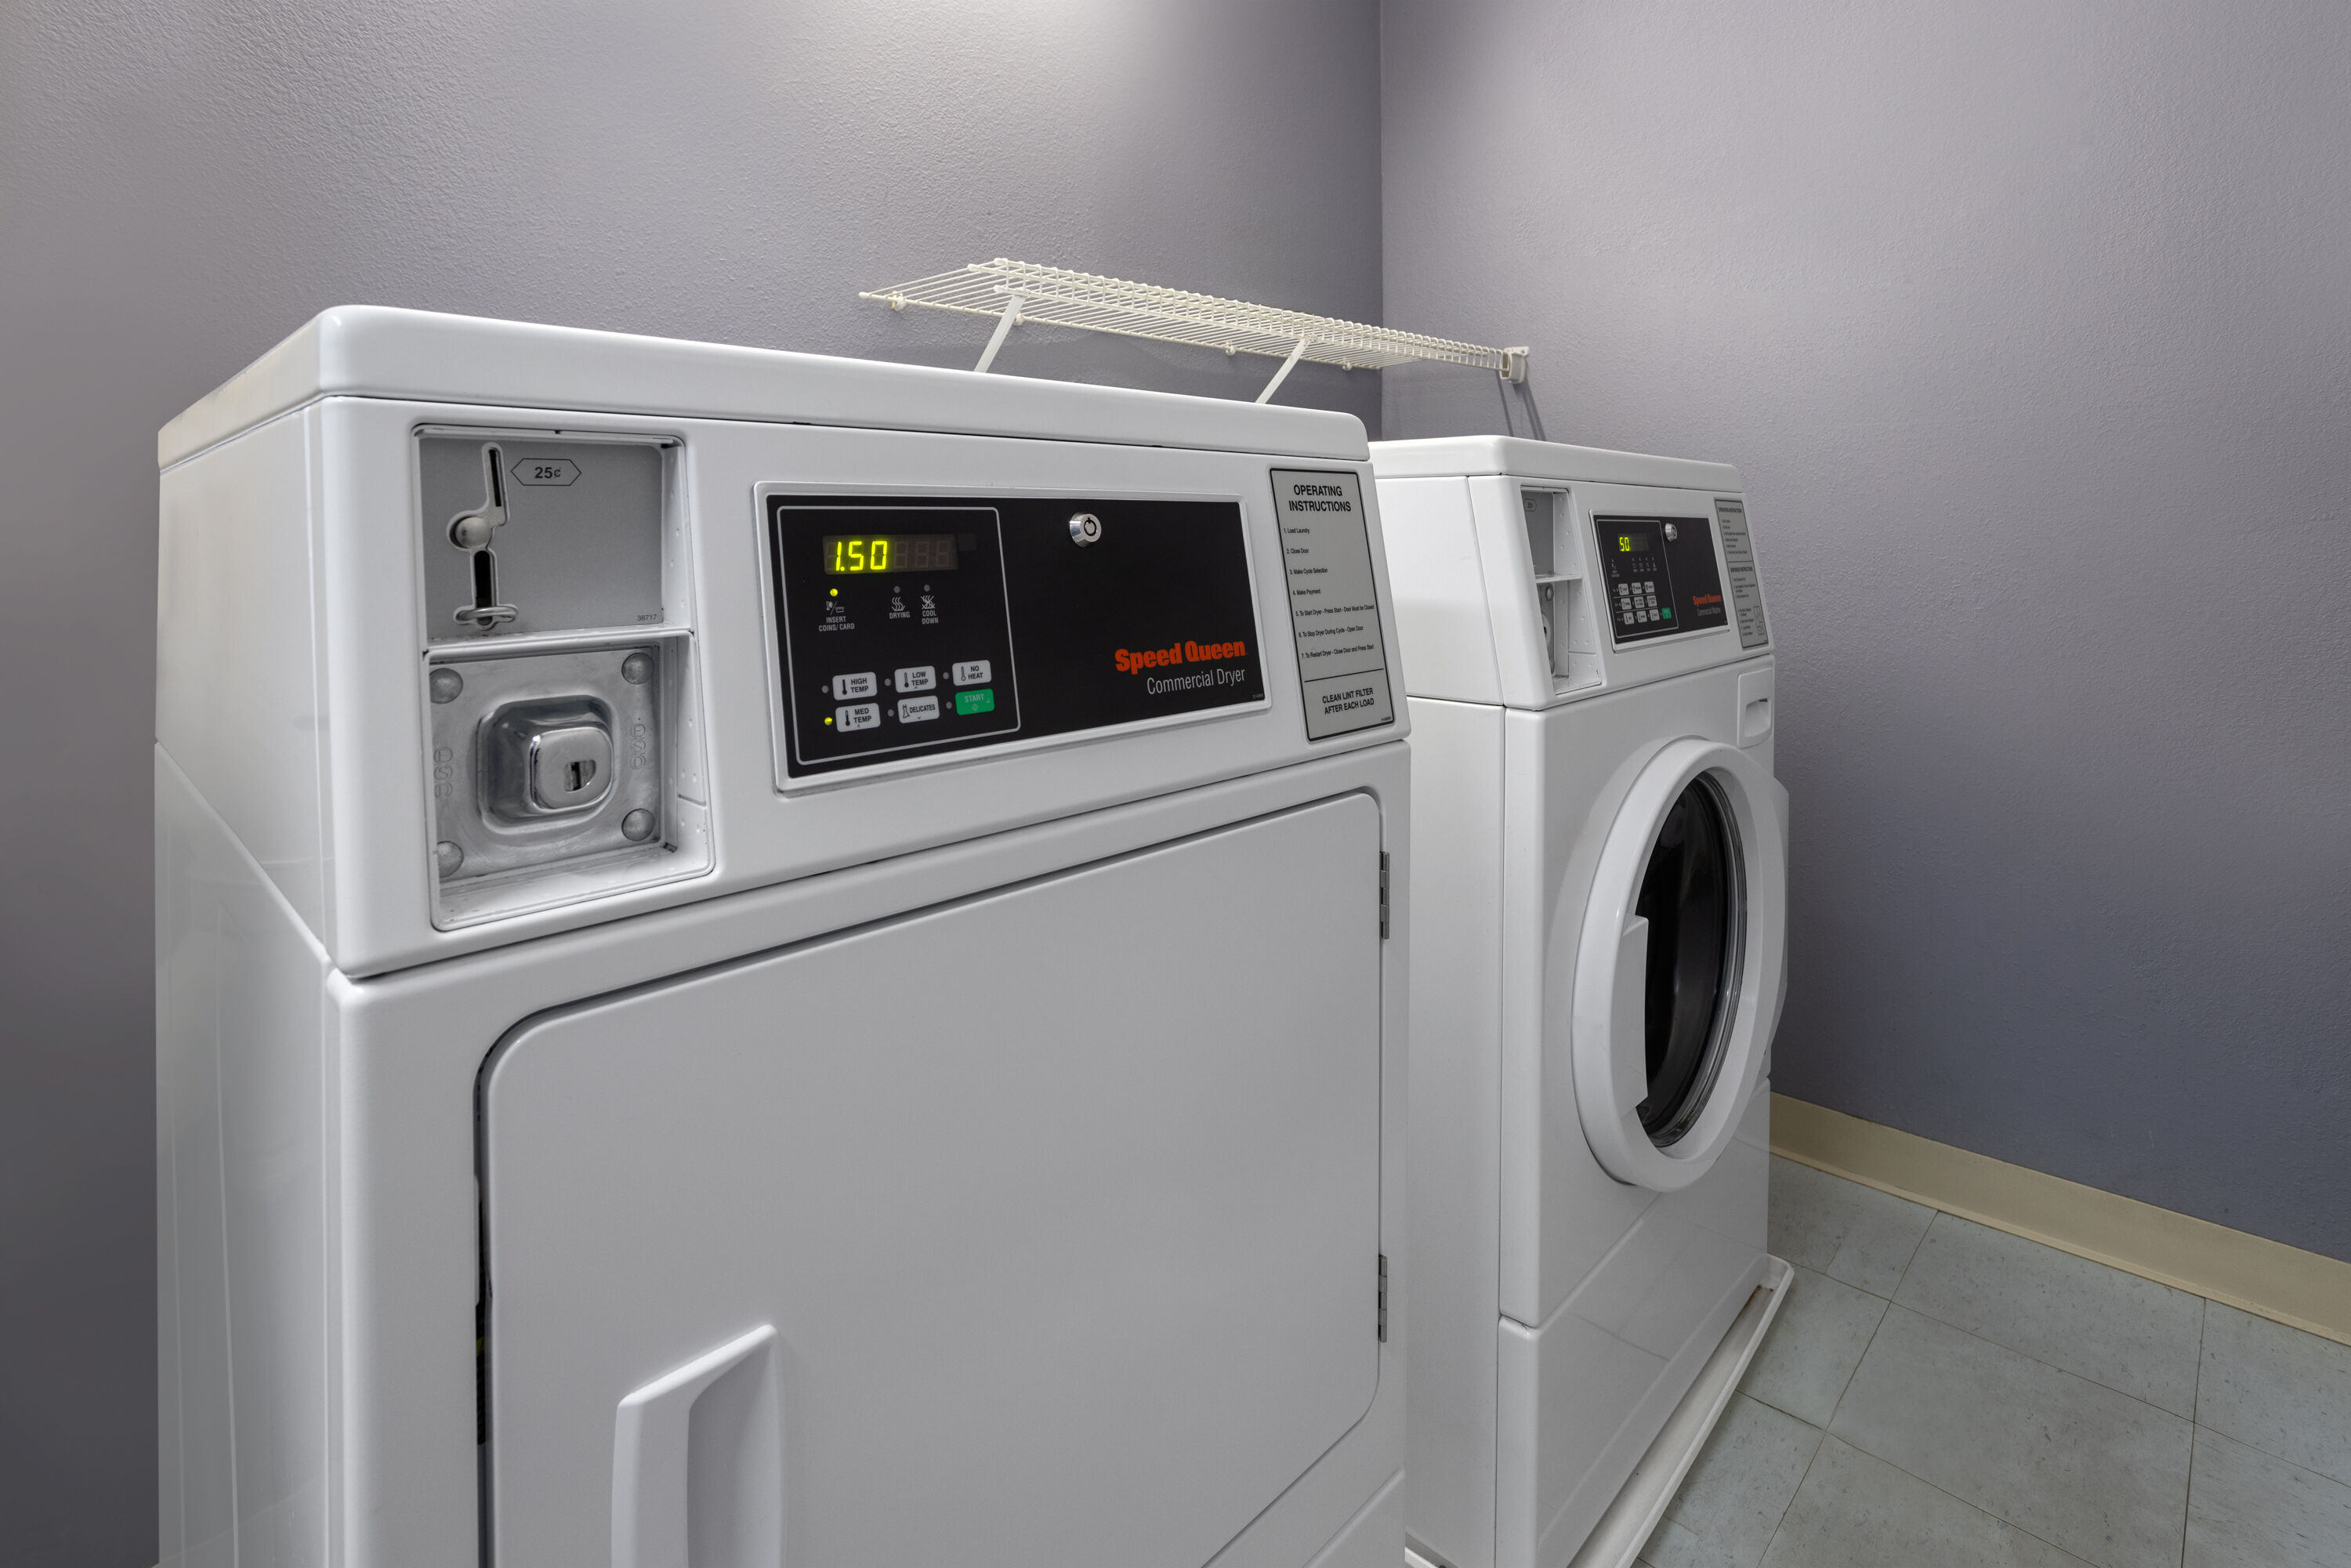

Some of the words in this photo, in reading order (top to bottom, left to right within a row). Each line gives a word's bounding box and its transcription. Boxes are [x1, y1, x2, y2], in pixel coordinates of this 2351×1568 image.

[534, 466, 561, 479] 25¢
[1294, 484, 1342, 496] OPERATING
[1288, 500, 1351, 512] INSTRUCTIONS
[835, 541, 888, 571] 1.50
[1114, 643, 1183, 675] Speed
[1185, 640, 1246, 662] Queen
[1147, 670, 1214, 694] Commercial
[1217, 668, 1245, 687] Dryer
[850, 685, 868, 693] TEMP
[964, 693, 984, 703] START
[1322, 693, 1342, 704] CLEAN
[1342, 690, 1354, 700] LINT
[1356, 687, 1374, 697] FILTER
[909, 704, 936, 713] DELICATES
[1324, 704, 1343, 715] AFTER
[1344, 701, 1359, 711] EACH
[1360, 698, 1375, 708] LOAD
[853, 715, 871, 724] TEMP
